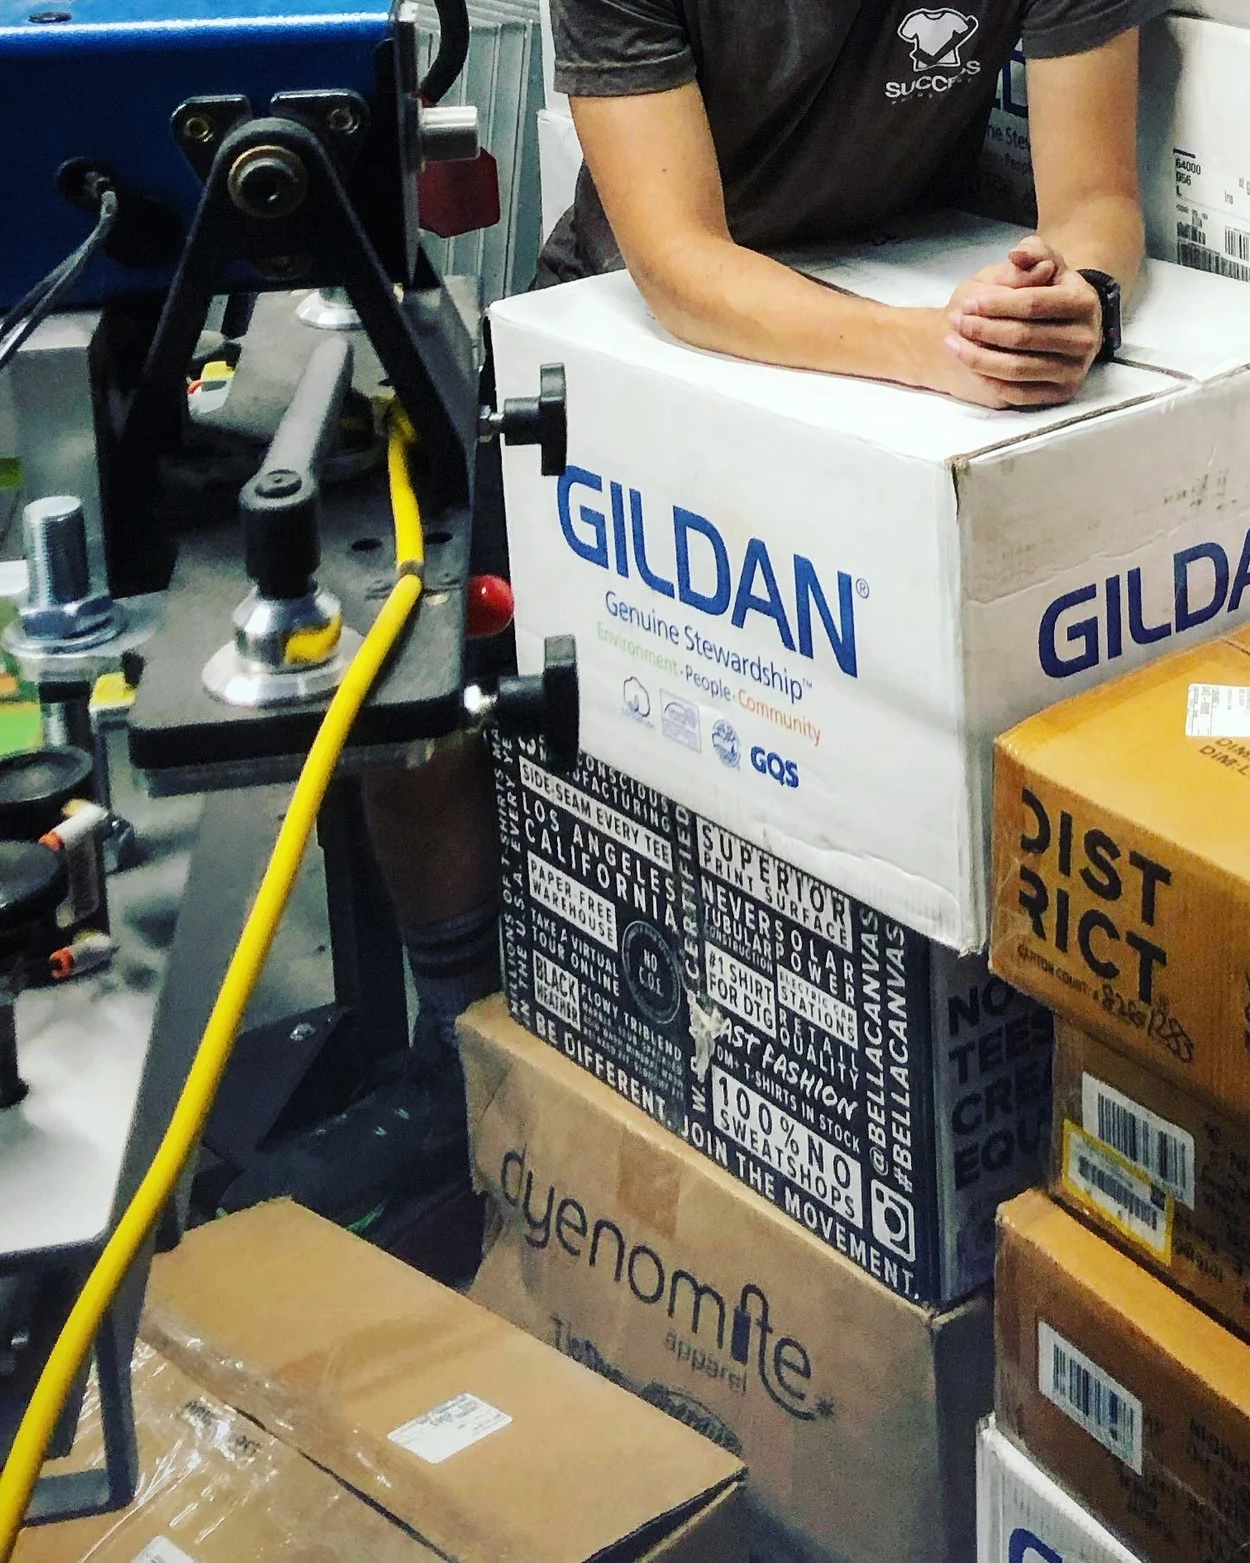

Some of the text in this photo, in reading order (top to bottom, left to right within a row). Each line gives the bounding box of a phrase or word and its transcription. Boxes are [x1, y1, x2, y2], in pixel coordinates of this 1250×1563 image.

[885, 60, 981, 98] SUCCS
[557, 465, 858, 679] GILDAN
[605, 590, 805, 704] Genuine Stewardship
[737, 691, 822, 746] Community
[750, 745, 800, 789] GQS
[522, 792, 675, 901] LOS ANGELES
[597, 809, 670, 864] EVERY TEE
[525, 819, 679, 935] CALIFORNIA
[701, 875, 770, 939] NEVER
[702, 824, 845, 926] SUPERIOR
[704, 850, 847, 947] PRINT SURFACE
[533, 879, 613, 942] WAREHOUSE
[704, 903, 772, 961] TUBULAR
[532, 926, 619, 997] TOUR ONLINE
[536, 955, 576, 1004] BLACK
[572, 935, 618, 978] VIRTUAL
[775, 919, 854, 983] SOLAR
[776, 943, 855, 1005] POWER
[709, 975, 773, 1030] FOR DTG
[730, 963, 772, 1004] SHIRT
[781, 988, 855, 1041] STATIONS
[581, 984, 618, 1019] FLOWY
[624, 1013, 681, 1060] TRIBLEND
[780, 1009, 858, 1072] RETAIL
[860, 908, 888, 1176] @BELLACANVAS
[762, 1042, 859, 1120] FASHION
[780, 1027, 858, 1090] QUALITY
[886, 923, 913, 1193] #BELLACANVAS
[536, 1011, 558, 1045] BE
[682, 1115, 727, 1167] JOIN
[735, 1151, 775, 1200] THE
[719, 1077, 850, 1189] 100% NO
[801, 1101, 859, 1153] IN STOCK
[720, 1109, 854, 1219] SWEATSHOPS
[665, 1330, 747, 1396] apparel
